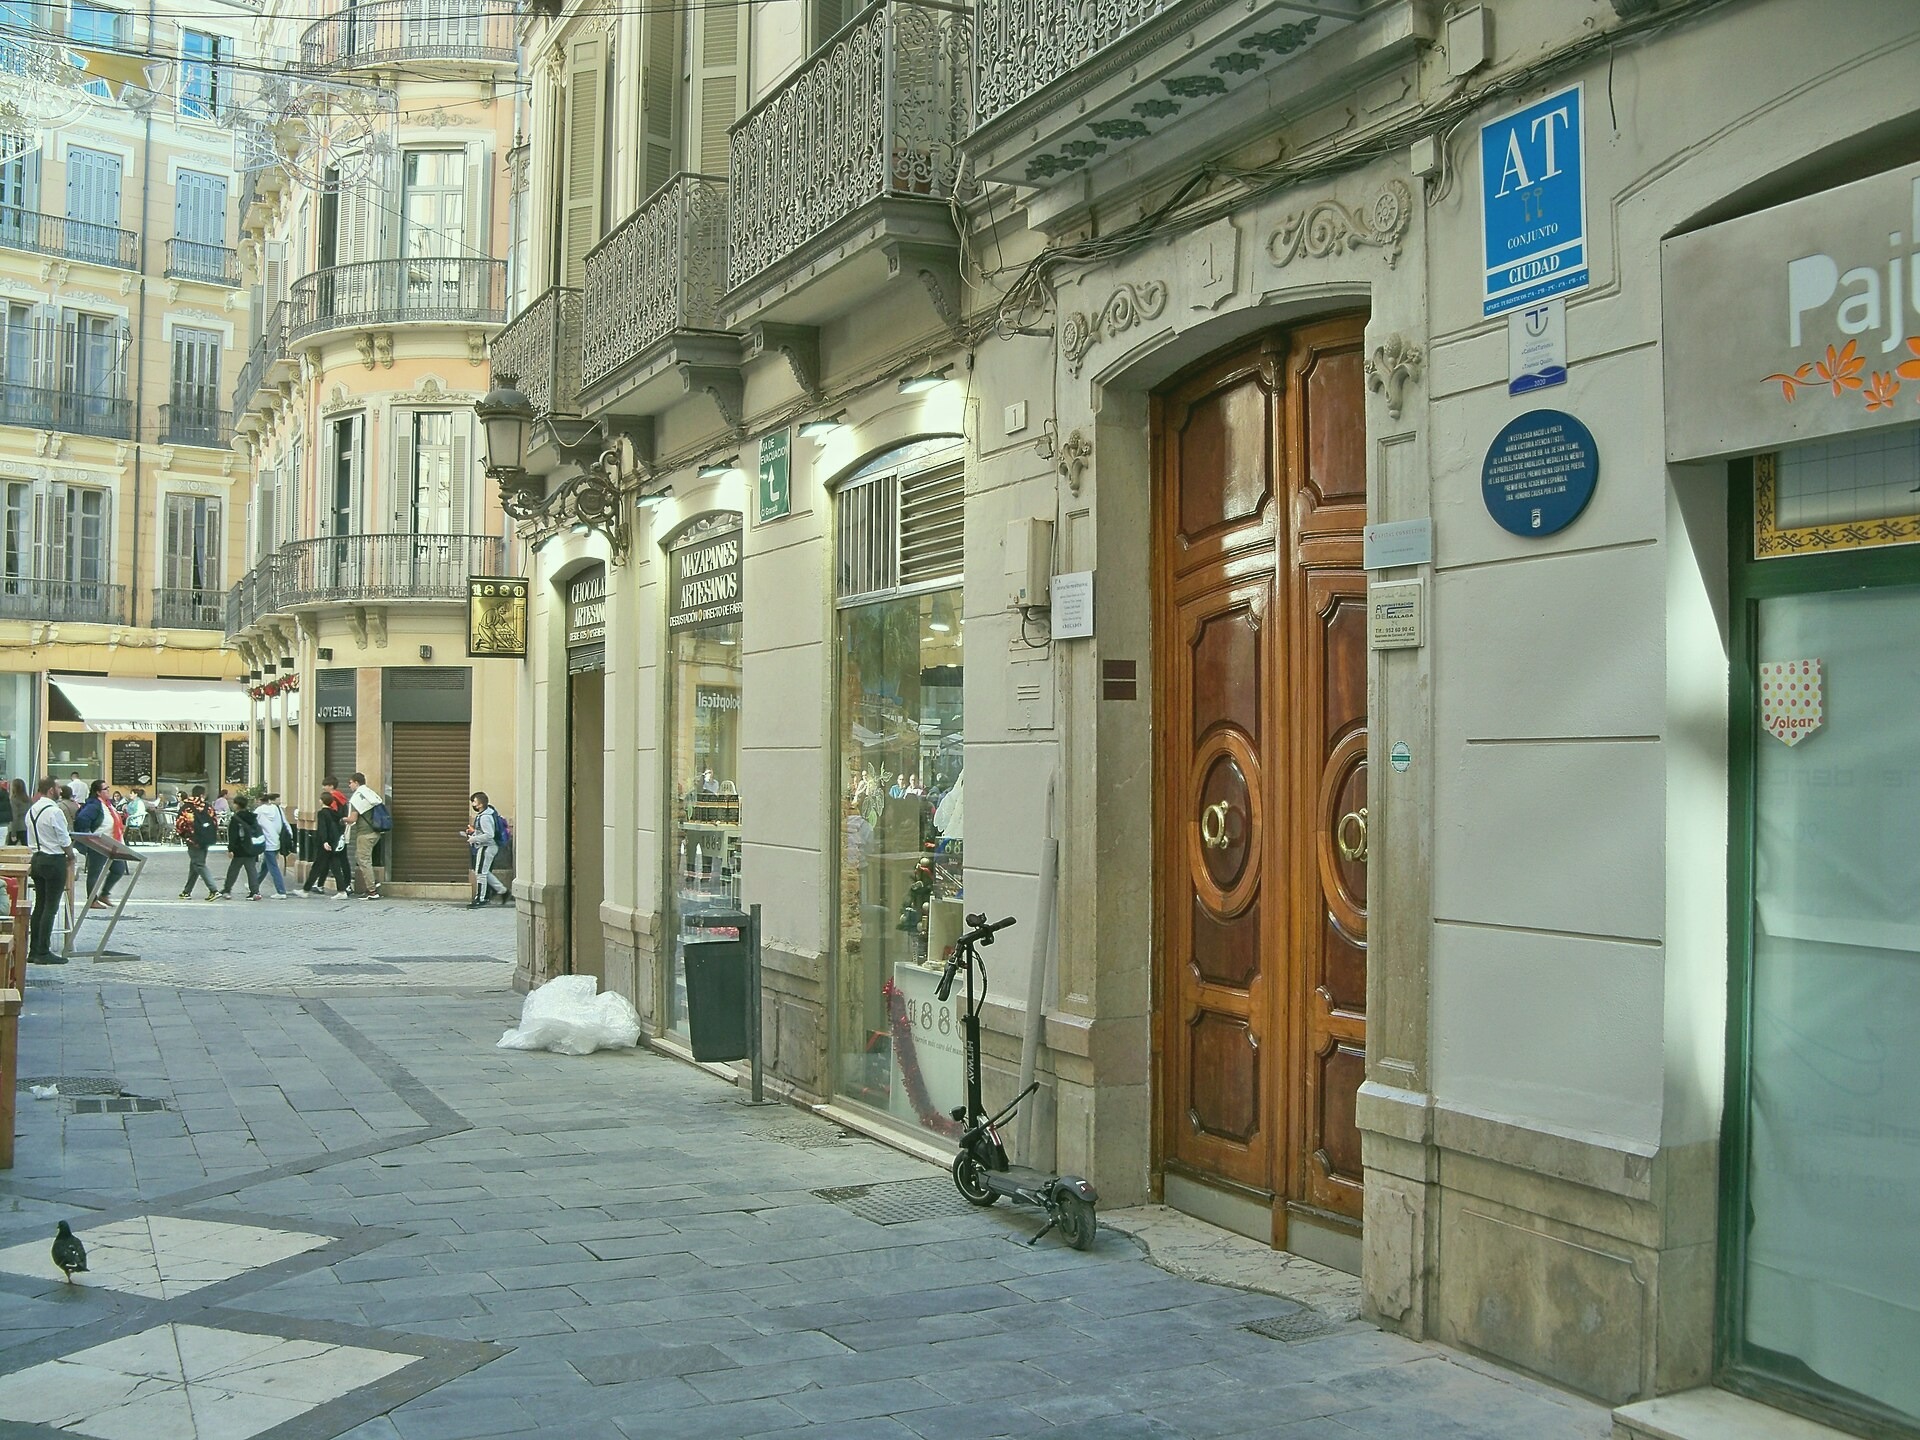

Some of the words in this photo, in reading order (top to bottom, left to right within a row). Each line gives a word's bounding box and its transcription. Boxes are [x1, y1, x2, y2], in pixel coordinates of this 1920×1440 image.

[1495, 106, 1568, 198] AT
[1508, 222, 1558, 250] CONJUNTO
[1509, 254, 1560, 284] CIUDAD
[1788, 231, 1920, 354] Paj
[1534, 378, 1546, 387] 2020
[1012, 408, 1017, 427] 1
[680, 540, 738, 580] MAZAPANES
[572, 576, 605, 604] CHOCOLA
[680, 572, 738, 610] ARTESANOS
[130, 721, 174, 731] TABERNA
[1770, 716, 1814, 730] Solear
